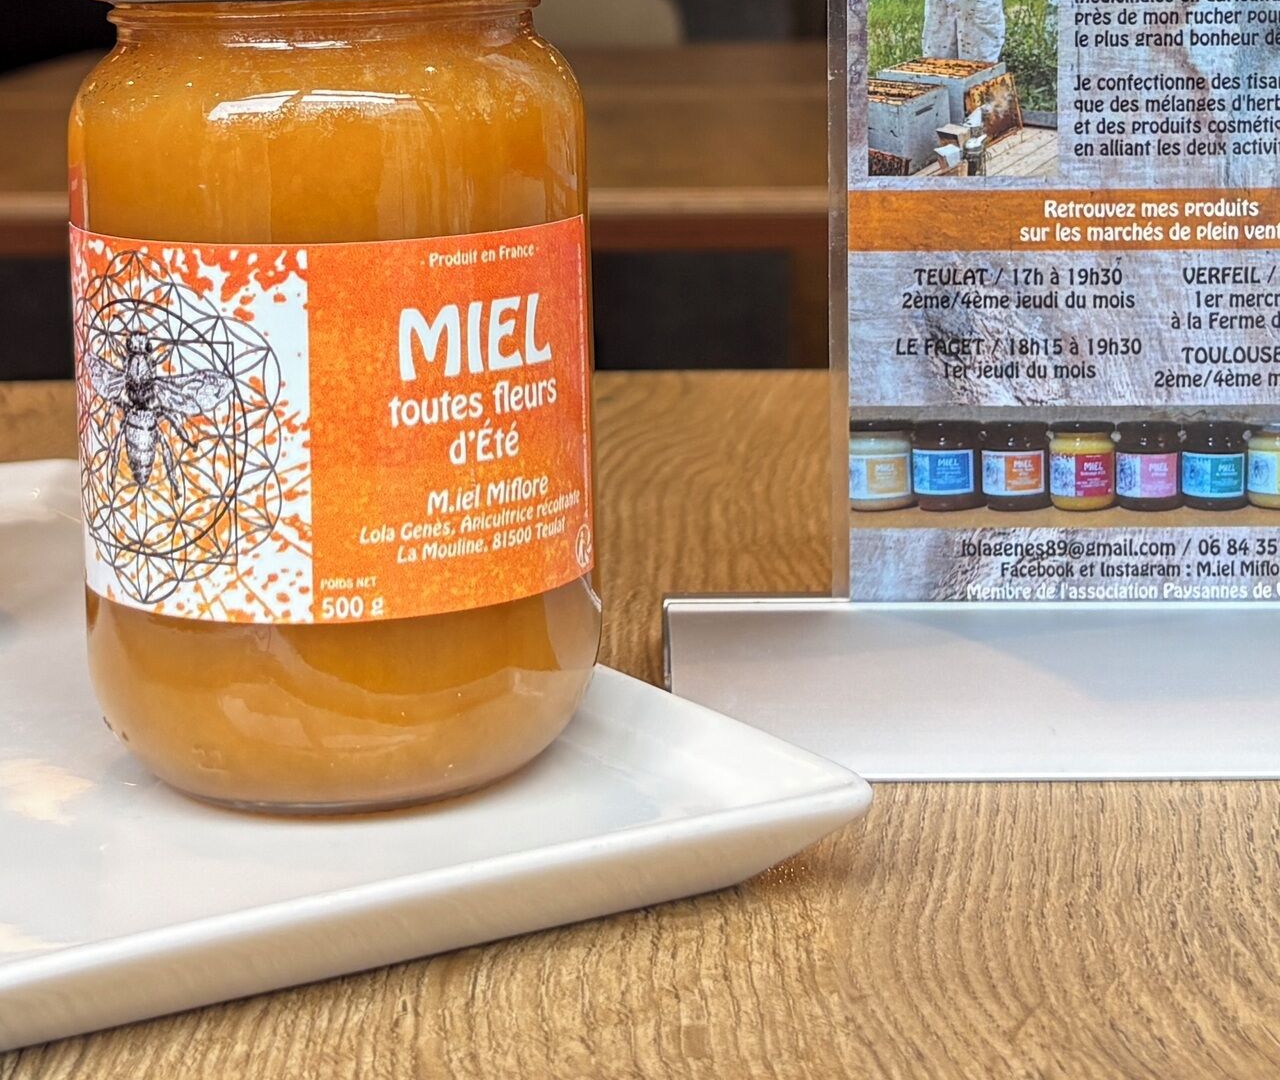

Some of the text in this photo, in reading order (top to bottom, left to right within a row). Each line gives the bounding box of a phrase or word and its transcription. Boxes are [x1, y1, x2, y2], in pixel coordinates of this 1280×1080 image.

[1073, 74, 1091, 90] Je
[1097, 73, 1206, 90] confectionne
[1212, 72, 1240, 89] des
[1075, 97, 1104, 113] que
[1110, 96, 1139, 112] des
[1145, 96, 1226, 112] mélanges
[1075, 119, 1091, 135] et
[1096, 119, 1125, 134] des
[1132, 118, 1201, 134] produits
[1043, 199, 1258, 218] Retrouvez mes produits
[1019, 224, 1049, 242] sur
[1055, 224, 1081, 241] les
[1086, 223, 1163, 241] marchés
[1169, 222, 1191, 240] de
[1196, 222, 1239, 240] plein
[429, 244, 534, 269] Produit en France
[914, 267, 1122, 286] TEULAT / 17h à 19h30
[1182, 267, 1259, 284] VERFEIL
[1268, 266, 1277, 283] /
[902, 290, 1134, 310] 2ème/4ème jeudi du mois
[1194, 290, 1222, 307] 1er
[399, 293, 552, 381] MIEL
[388, 379, 557, 428] toutes fleurs
[427, 475, 548, 516] M.iel Miflore
[360, 490, 580, 546] Lola Genès, Apicultrice récoltante
[397, 520, 565, 563] La Mouline, 81500 Teulat
[961, 538, 1175, 557] lolagenes89@gmail.com
[1182, 538, 1191, 556] /
[1197, 538, 1221, 556] 06
[1226, 538, 1251, 556] 84
[1255, 538, 1279, 555] 35
[1000, 561, 1074, 578] Facebook
[1080, 560, 1095, 578] et
[1100, 560, 1180, 577] Instagram
[1185, 561, 1191, 577] :
[1196, 560, 1235, 577] M.iel
[966, 582, 1030, 599] Membre
[1036, 582, 1055, 599] de
[1060, 582, 1157, 599] l'association
[1163, 581, 1247, 598] Paysannes
[1253, 581, 1272, 598] de
[322, 598, 384, 617] 500 g
